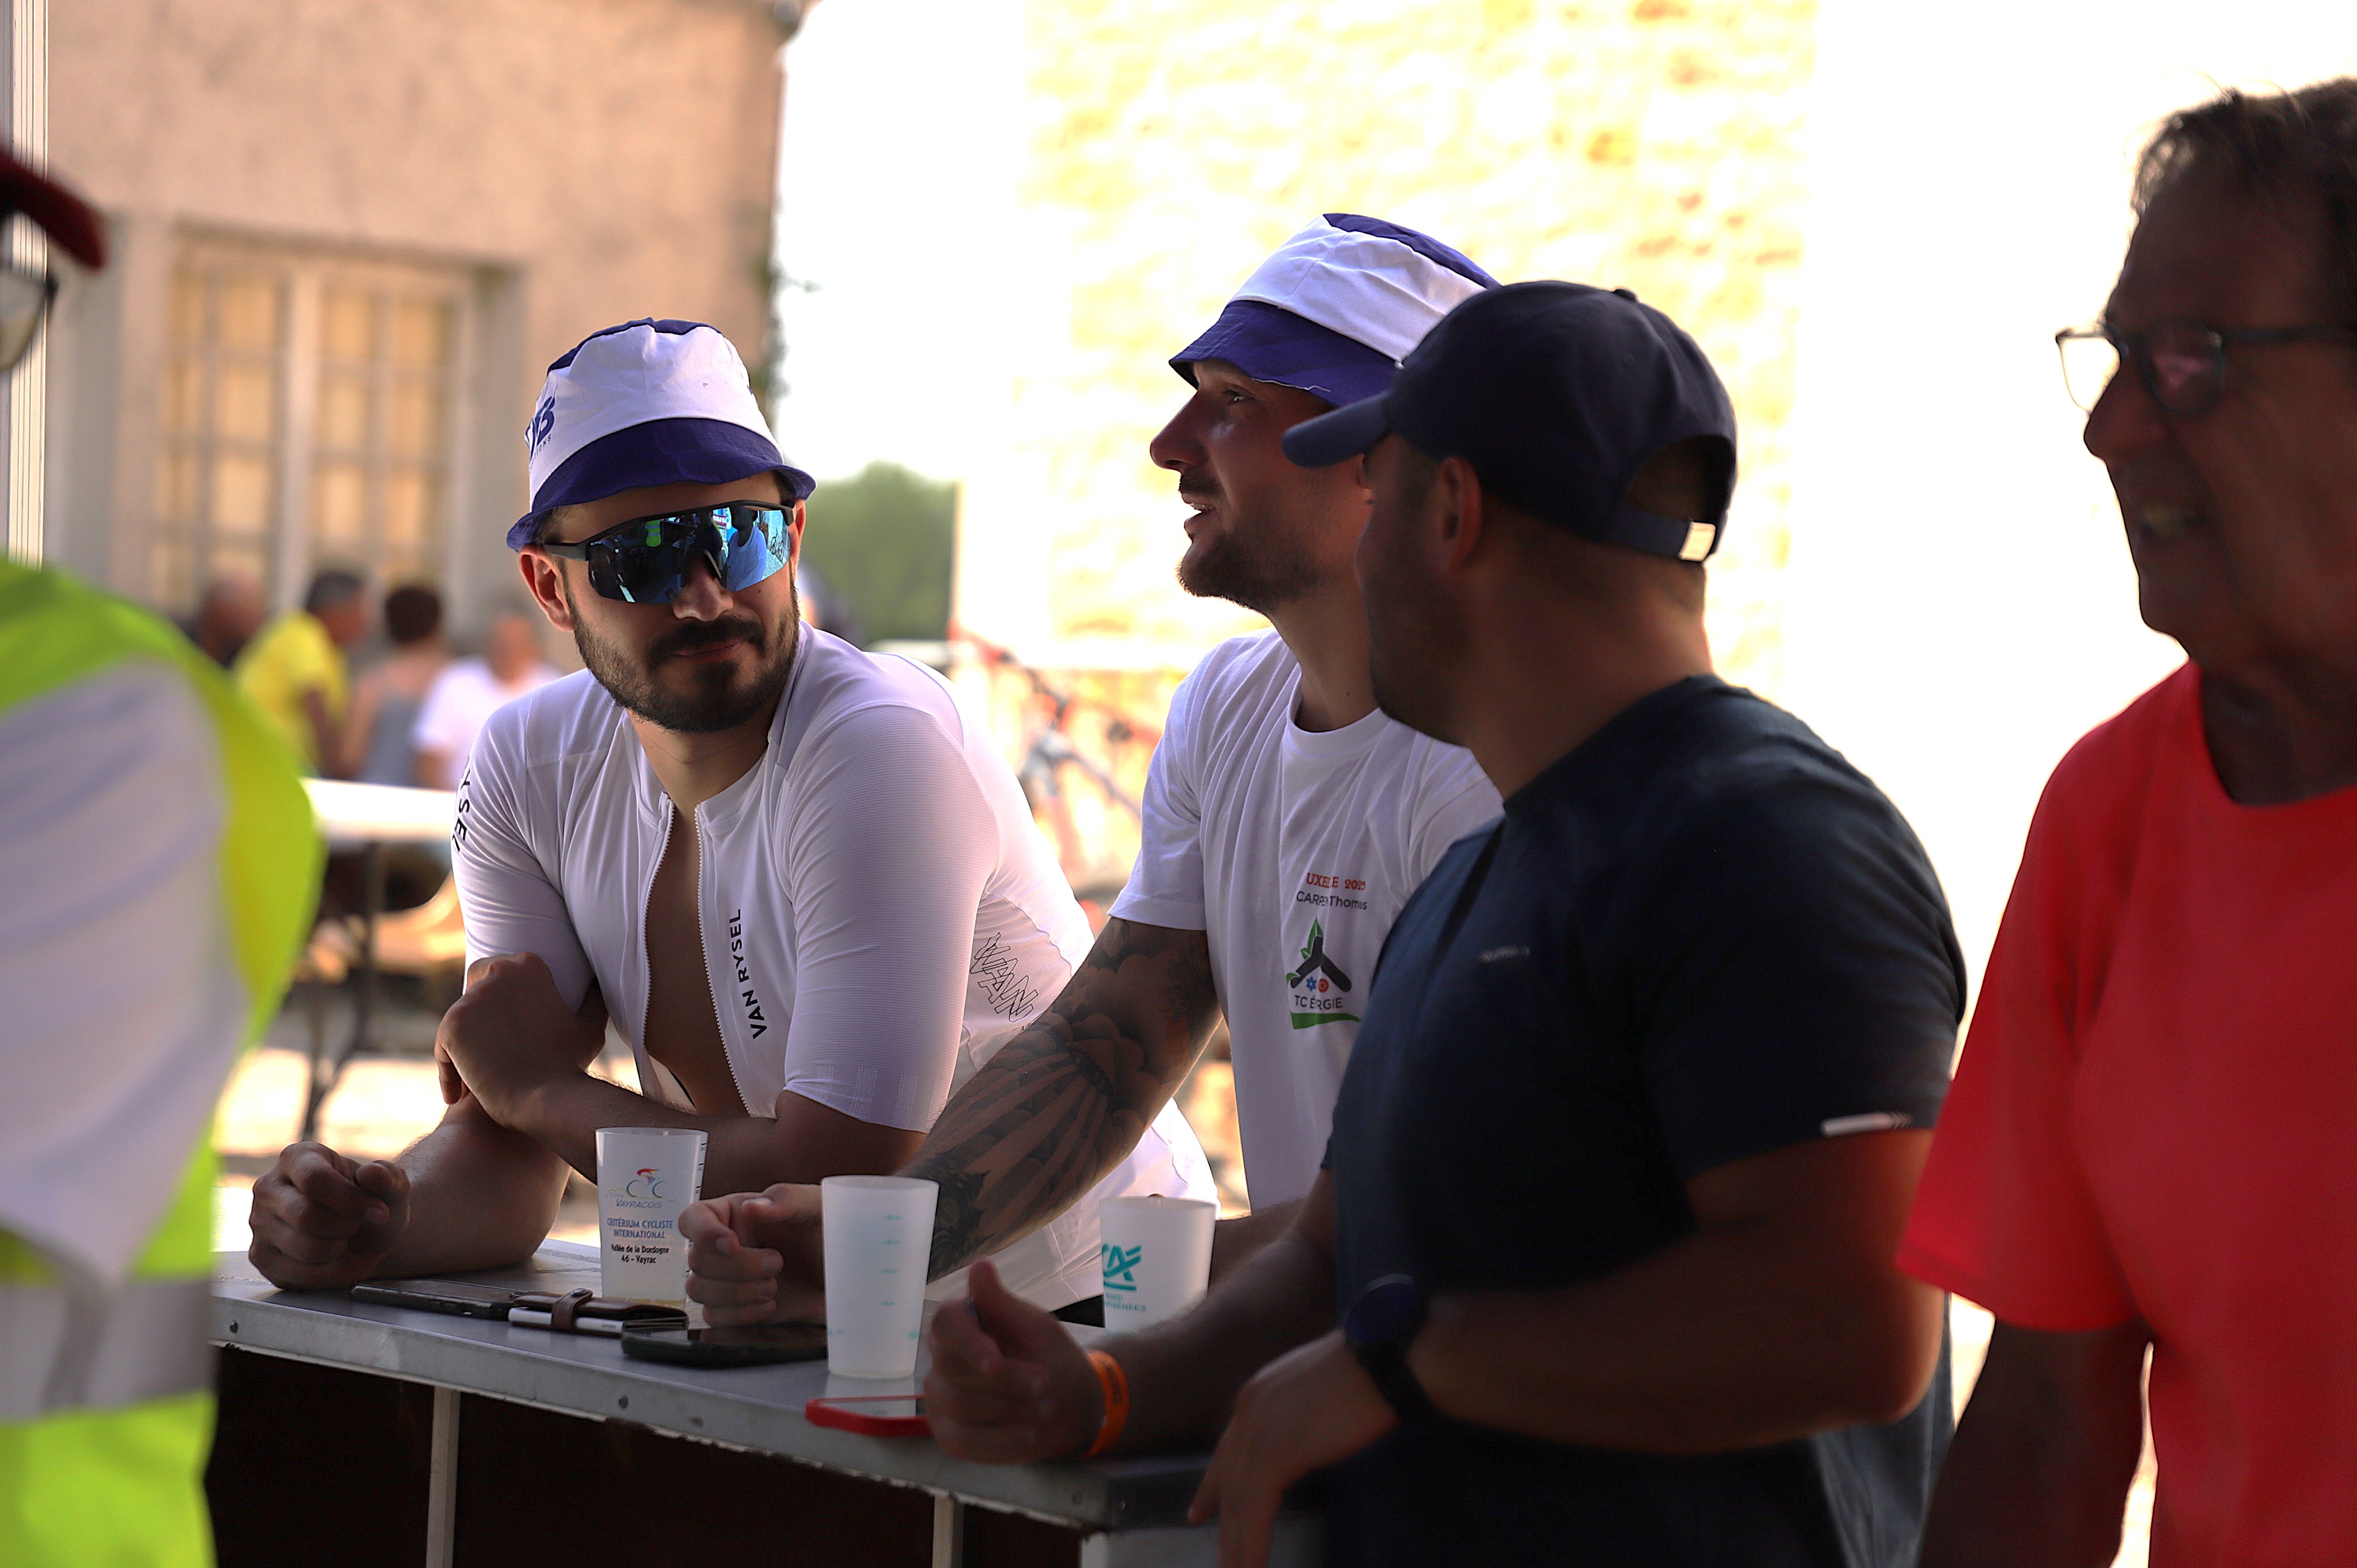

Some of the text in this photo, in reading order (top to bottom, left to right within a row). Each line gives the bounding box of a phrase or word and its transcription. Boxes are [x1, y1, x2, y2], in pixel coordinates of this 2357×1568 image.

[729, 909, 767, 1039] VAN RYSEL
[1295, 995, 1307, 1007] TC
[616, 1199, 663, 1208] VAYRACOIS
[607, 1217, 674, 1229] CRITÉRIUM CYCLISTE
[614, 1229, 666, 1238] INTERNATIONAL
[641, 1246, 670, 1255] Dordogne
[636, 1255, 657, 1264] Vayrac
